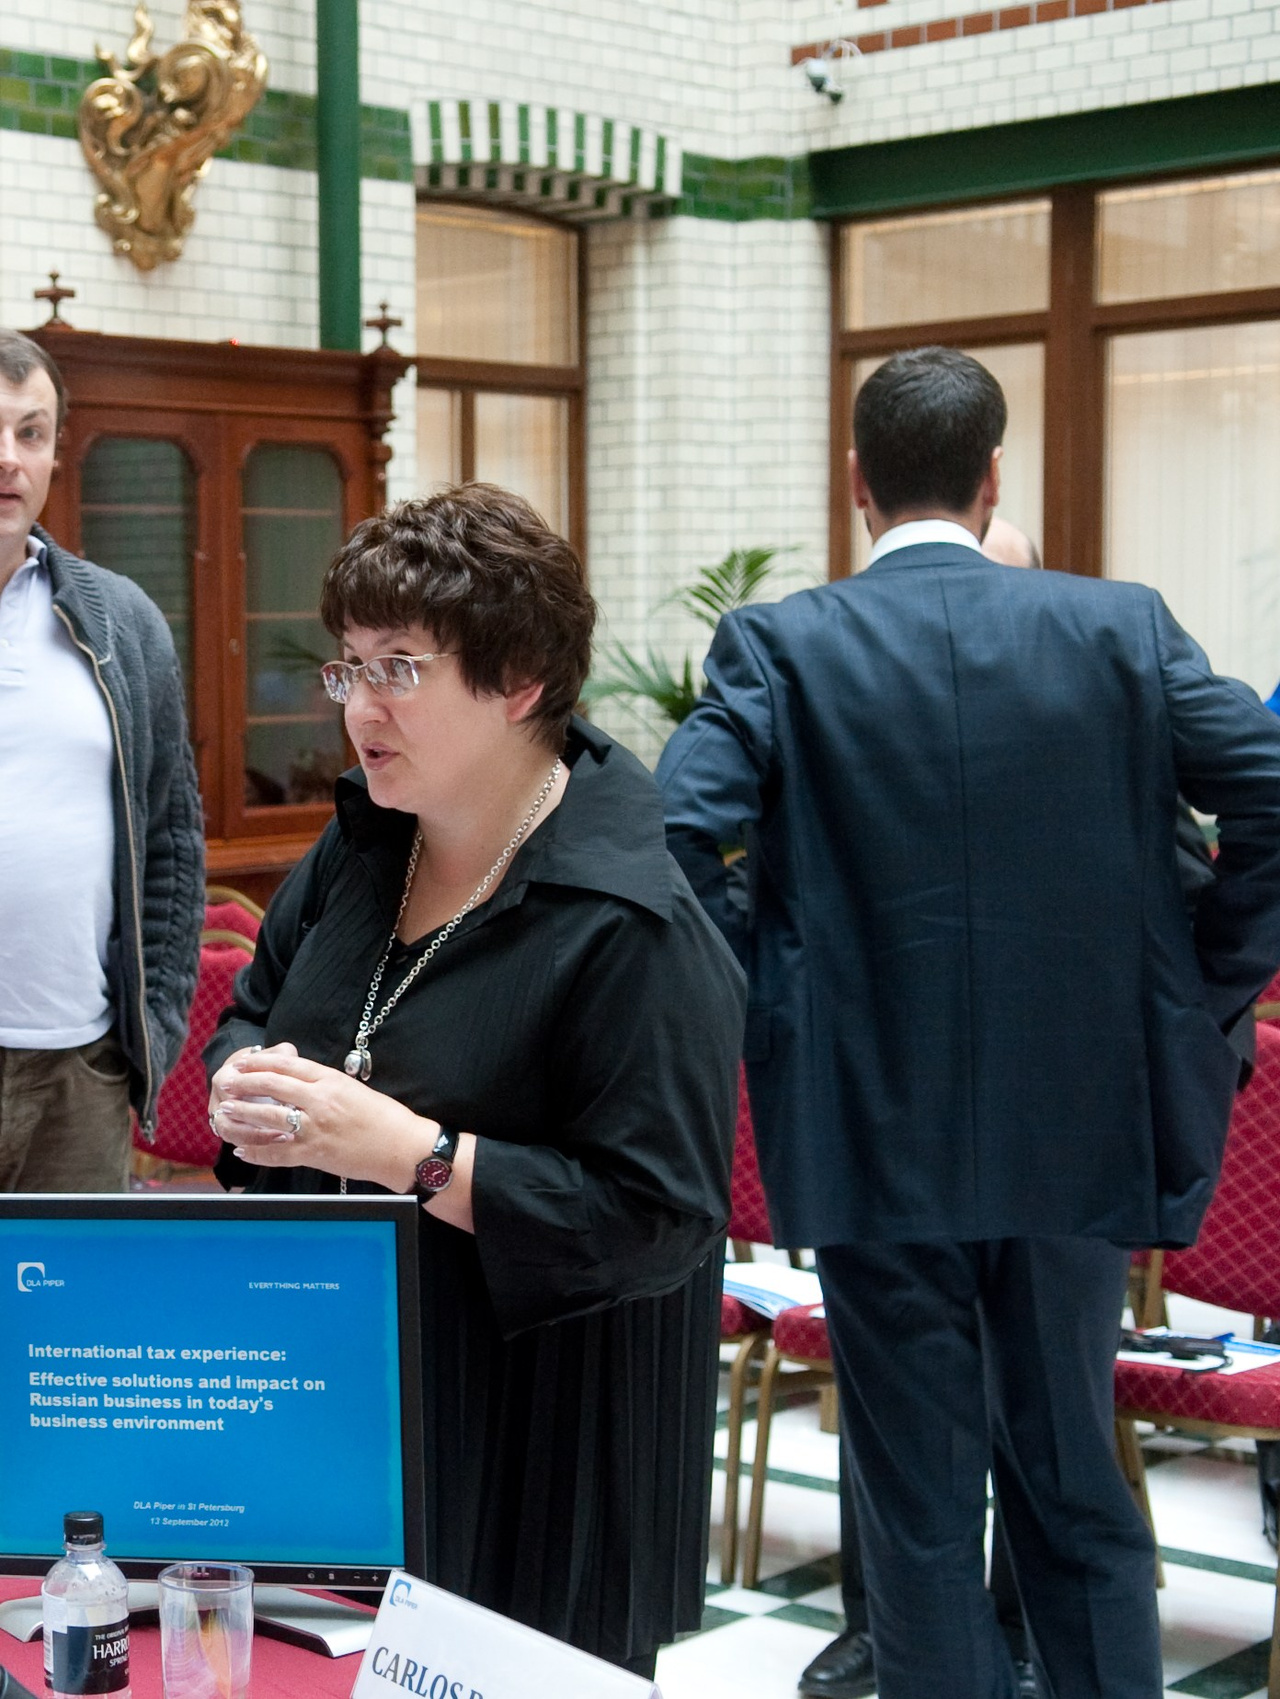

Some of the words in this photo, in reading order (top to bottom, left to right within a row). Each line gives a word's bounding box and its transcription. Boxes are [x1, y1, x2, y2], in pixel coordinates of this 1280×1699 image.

[26, 1279, 41, 1287] DLA
[42, 1279, 65, 1287] PIPER
[248, 1281, 300, 1290] EVERYTHING
[302, 1282, 340, 1290] MATTERS
[28, 1344, 142, 1359] International
[146, 1345, 176, 1359] tax
[180, 1346, 287, 1363] experience:
[29, 1372, 108, 1387] Effective
[112, 1373, 193, 1388] solutions
[198, 1375, 231, 1389] and
[236, 1375, 299, 1393] impact
[303, 1379, 326, 1391] on
[29, 1392, 99, 1407] Russian
[103, 1393, 182, 1409] business
[187, 1395, 203, 1409] in
[208, 1395, 274, 1414] today's
[30, 1413, 108, 1428] business
[112, 1415, 224, 1431] environment
[133, 1501, 151, 1510] DLA
[153, 1502, 176, 1511] Piper
[198, 1503, 245, 1514] Petersburg
[150, 1517, 160, 1525] 13
[162, 1517, 208, 1526] September
[209, 1518, 230, 1527] 2012
[372, 1646, 464, 1699] CARLOS
